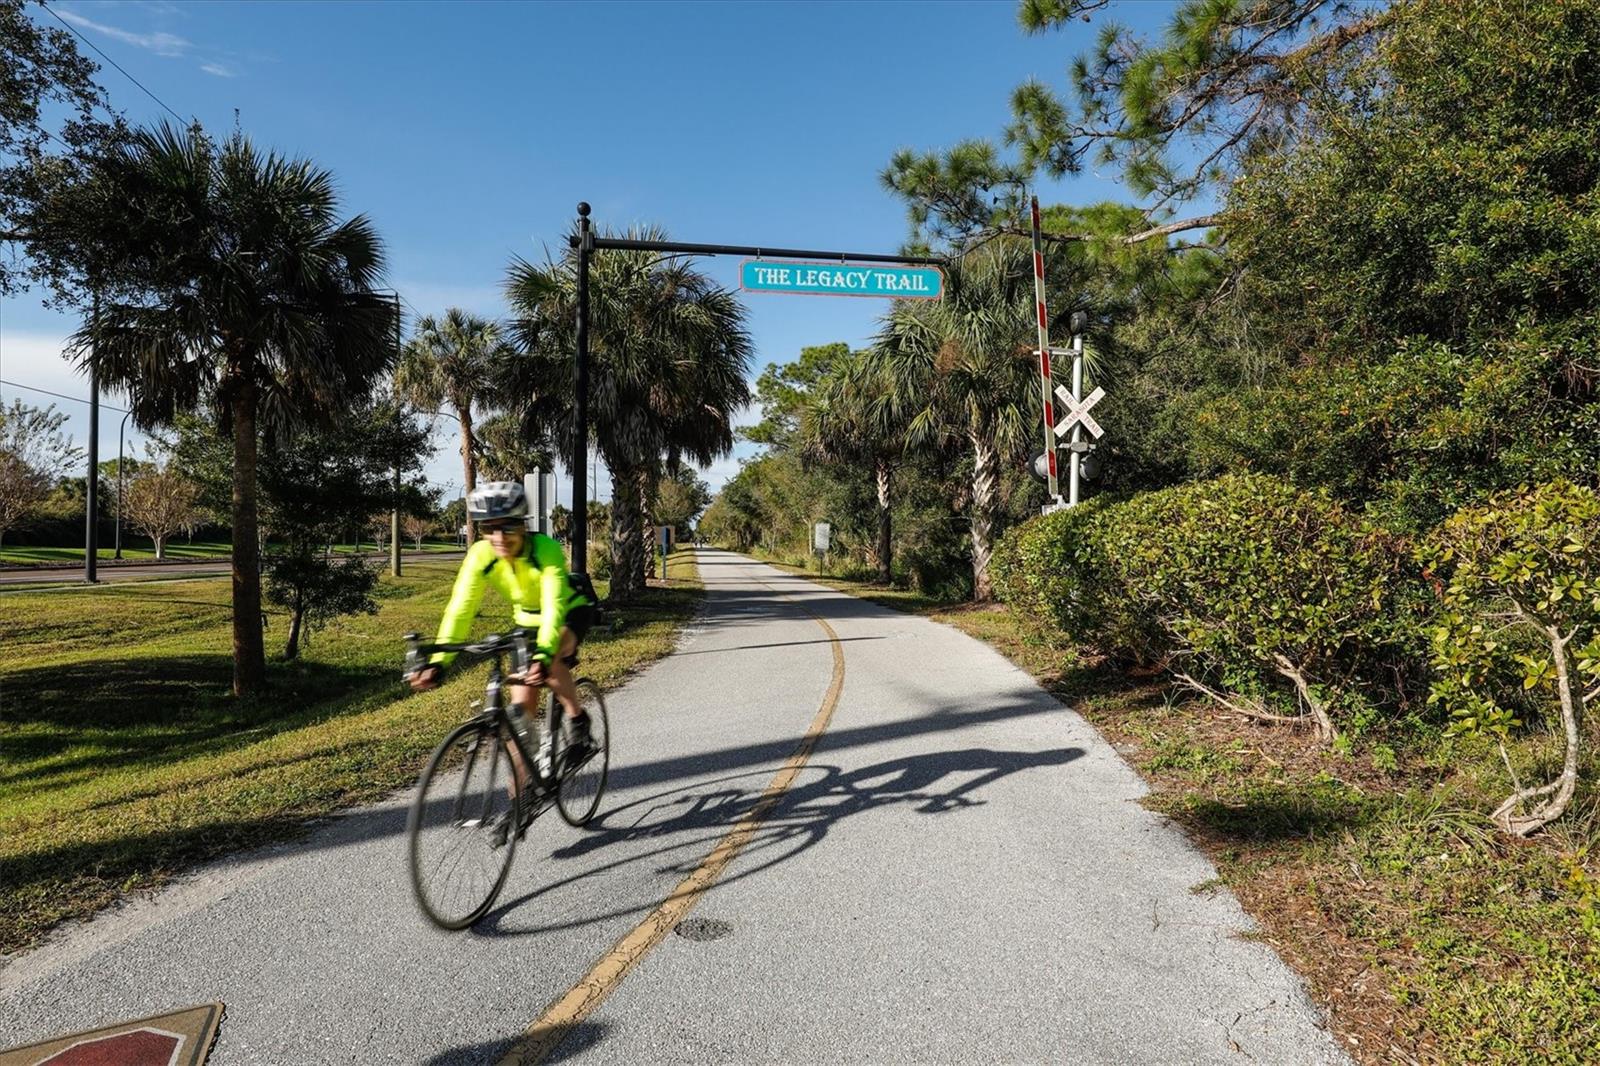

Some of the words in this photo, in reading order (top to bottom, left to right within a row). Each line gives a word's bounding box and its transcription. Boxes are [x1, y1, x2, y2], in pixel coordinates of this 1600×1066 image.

[754, 267, 791, 286] THE
[796, 269, 872, 289] LEGACY
[874, 272, 929, 291] TRAIL
[1060, 389, 1075, 405] RAIL
[1082, 413, 1101, 435] TRAIL
[1063, 397, 1096, 426] SARASOTA
